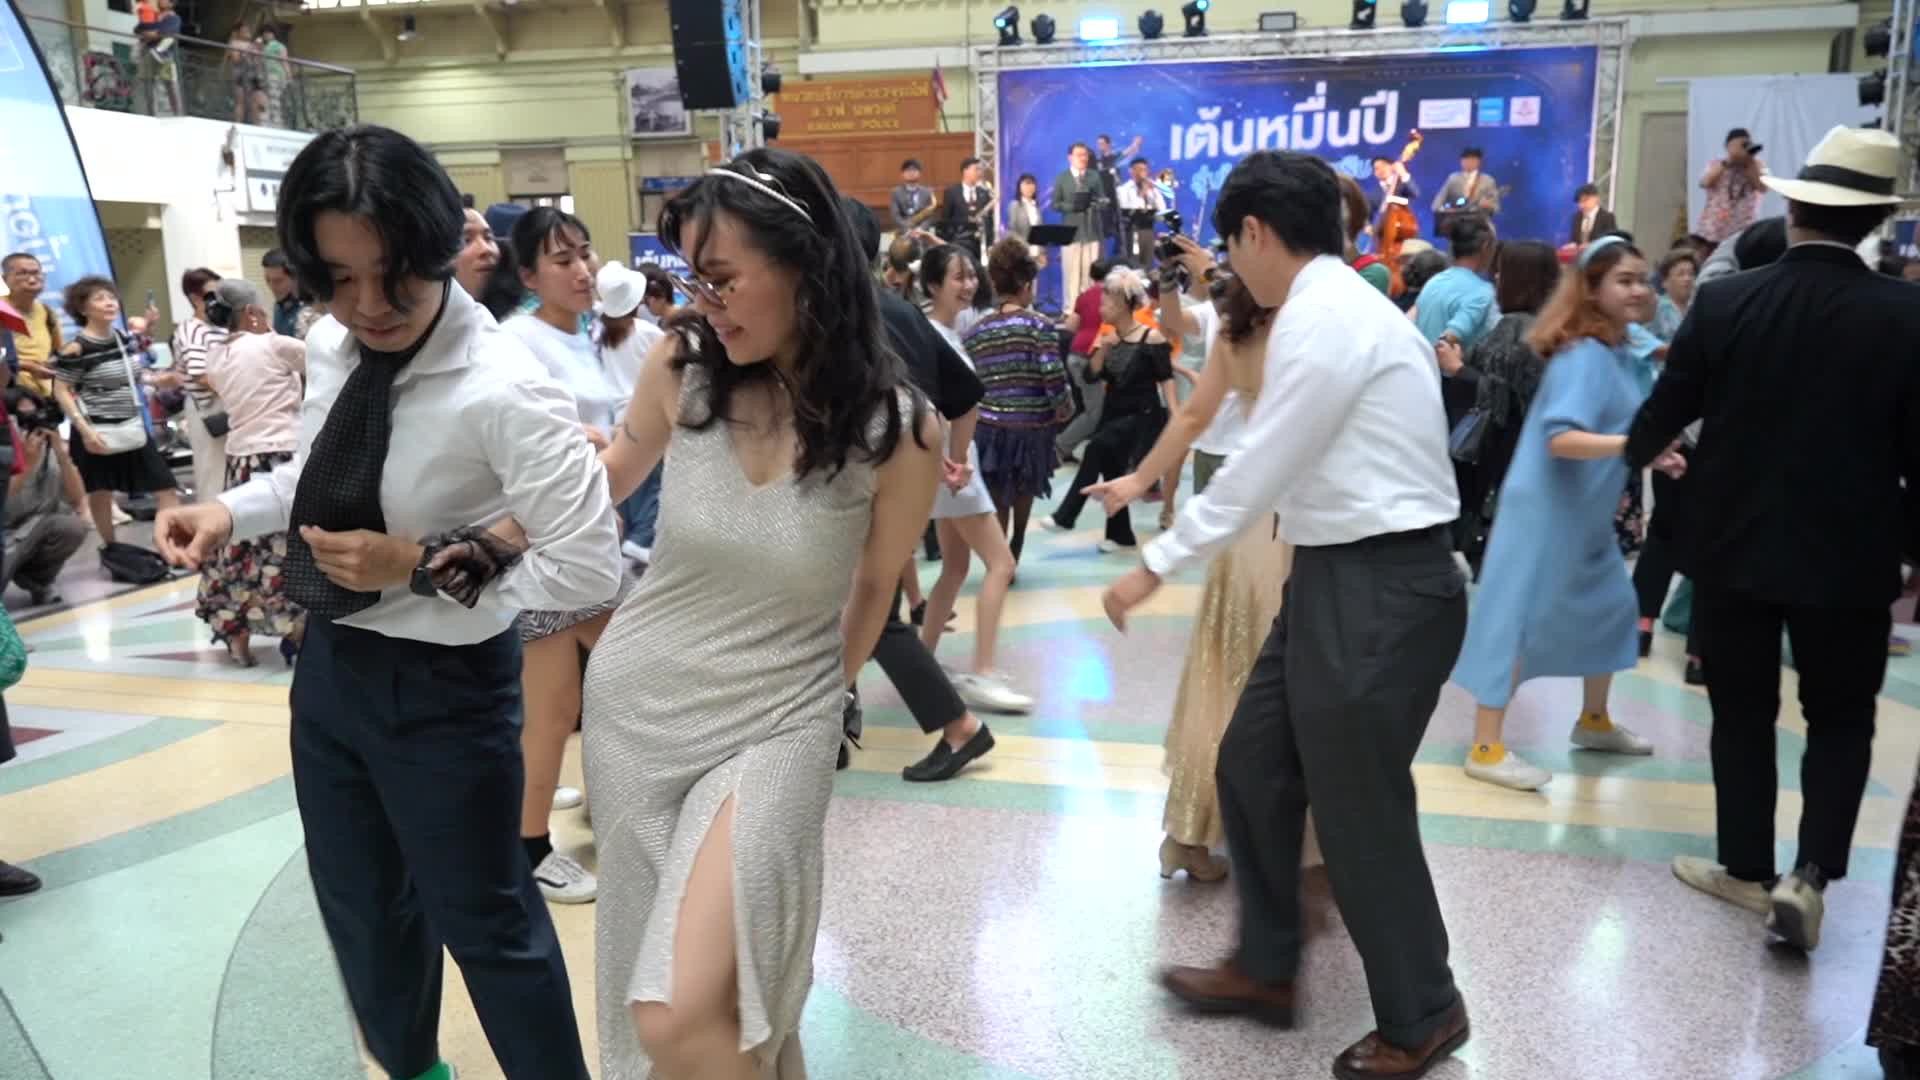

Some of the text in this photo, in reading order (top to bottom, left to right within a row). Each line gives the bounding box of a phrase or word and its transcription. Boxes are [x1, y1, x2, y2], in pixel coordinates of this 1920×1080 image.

[1170, 80, 1399, 160] เต้นหมื่นปี
